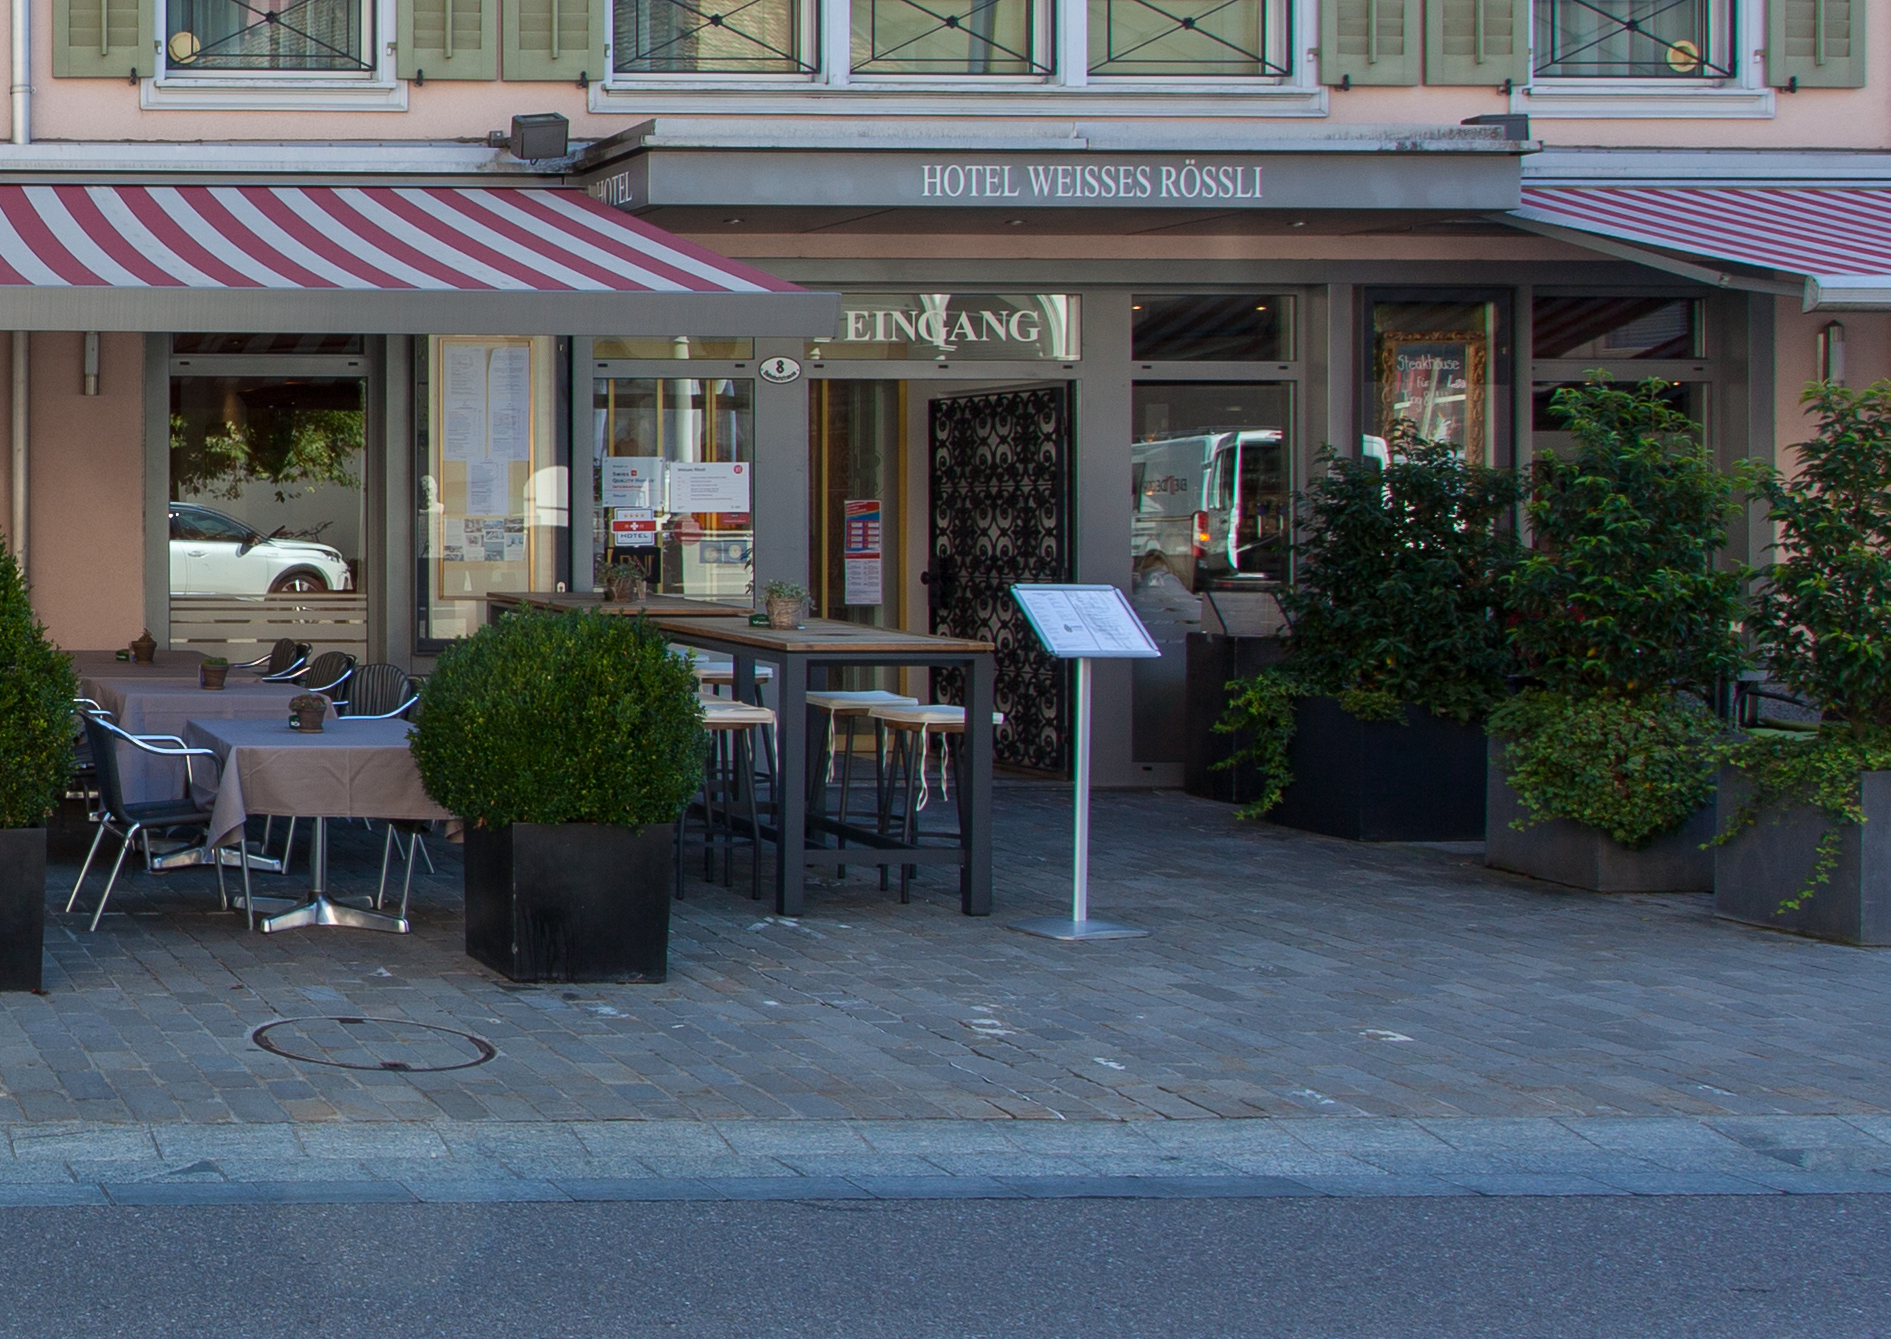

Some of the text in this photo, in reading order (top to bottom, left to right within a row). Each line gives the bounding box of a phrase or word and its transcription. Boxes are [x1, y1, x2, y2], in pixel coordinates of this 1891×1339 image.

[595, 171, 633, 207] HOTEL
[922, 157, 1262, 199] HOTEL WEISSES RÖSSLI
[843, 310, 1041, 342] EINGANG
[776, 360, 785, 374] 8
[1397, 354, 1460, 371] Steakhouse
